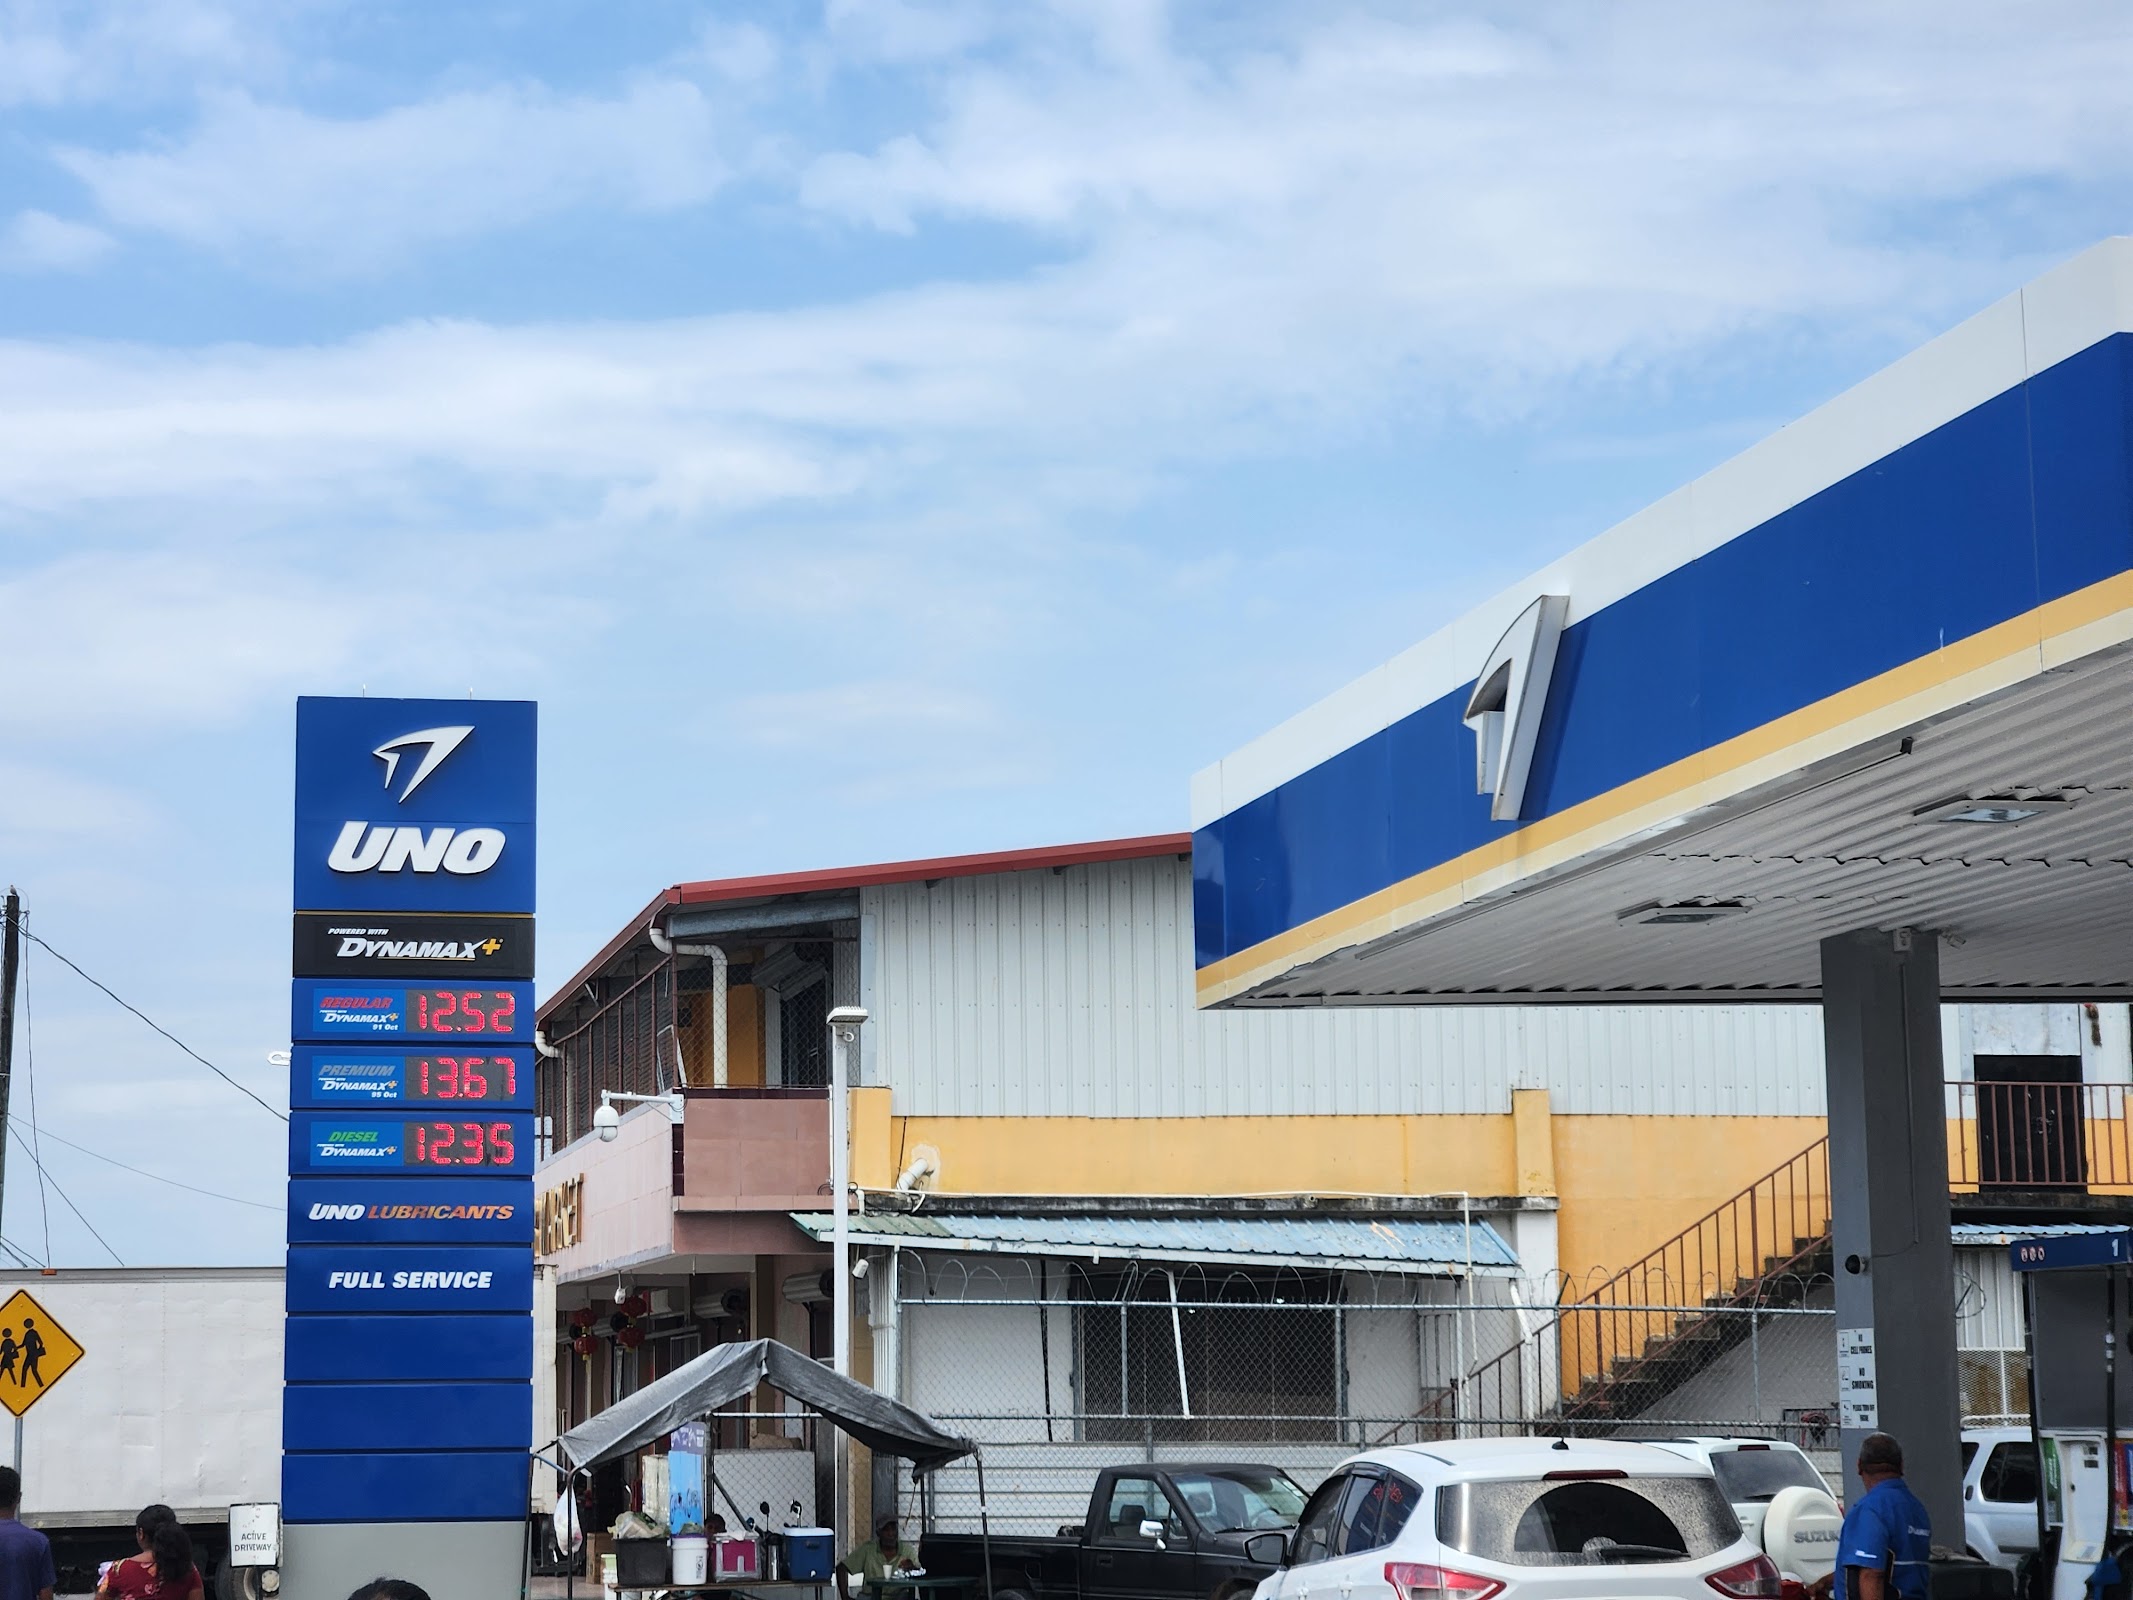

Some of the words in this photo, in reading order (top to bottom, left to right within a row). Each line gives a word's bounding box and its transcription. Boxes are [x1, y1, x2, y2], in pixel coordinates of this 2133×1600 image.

[327, 820, 506, 874] UNO
[367, 928, 389, 936] WITH
[320, 996, 394, 1009] REGULAR
[419, 992, 516, 1032] 12.52
[319, 1065, 396, 1077] PREMIUM
[421, 1057, 516, 1098] 13.67
[328, 1131, 379, 1142] DIESEL
[418, 1123, 515, 1164] 12.35
[308, 1203, 366, 1220] UNO
[368, 1205, 514, 1220] LUBRICANTS
[2111, 1238, 2119, 1257] 1
[328, 1272, 385, 1289] FULL
[392, 1272, 493, 1289] SERVICE
[1858, 1367, 1865, 1376] NO
[1851, 1380, 1874, 1390] SMOKING
[241, 1532, 267, 1541] ACTIVE
[1794, 1530, 1840, 1543] SUZUK
[234, 1544, 272, 1552] DRIVEWAY
